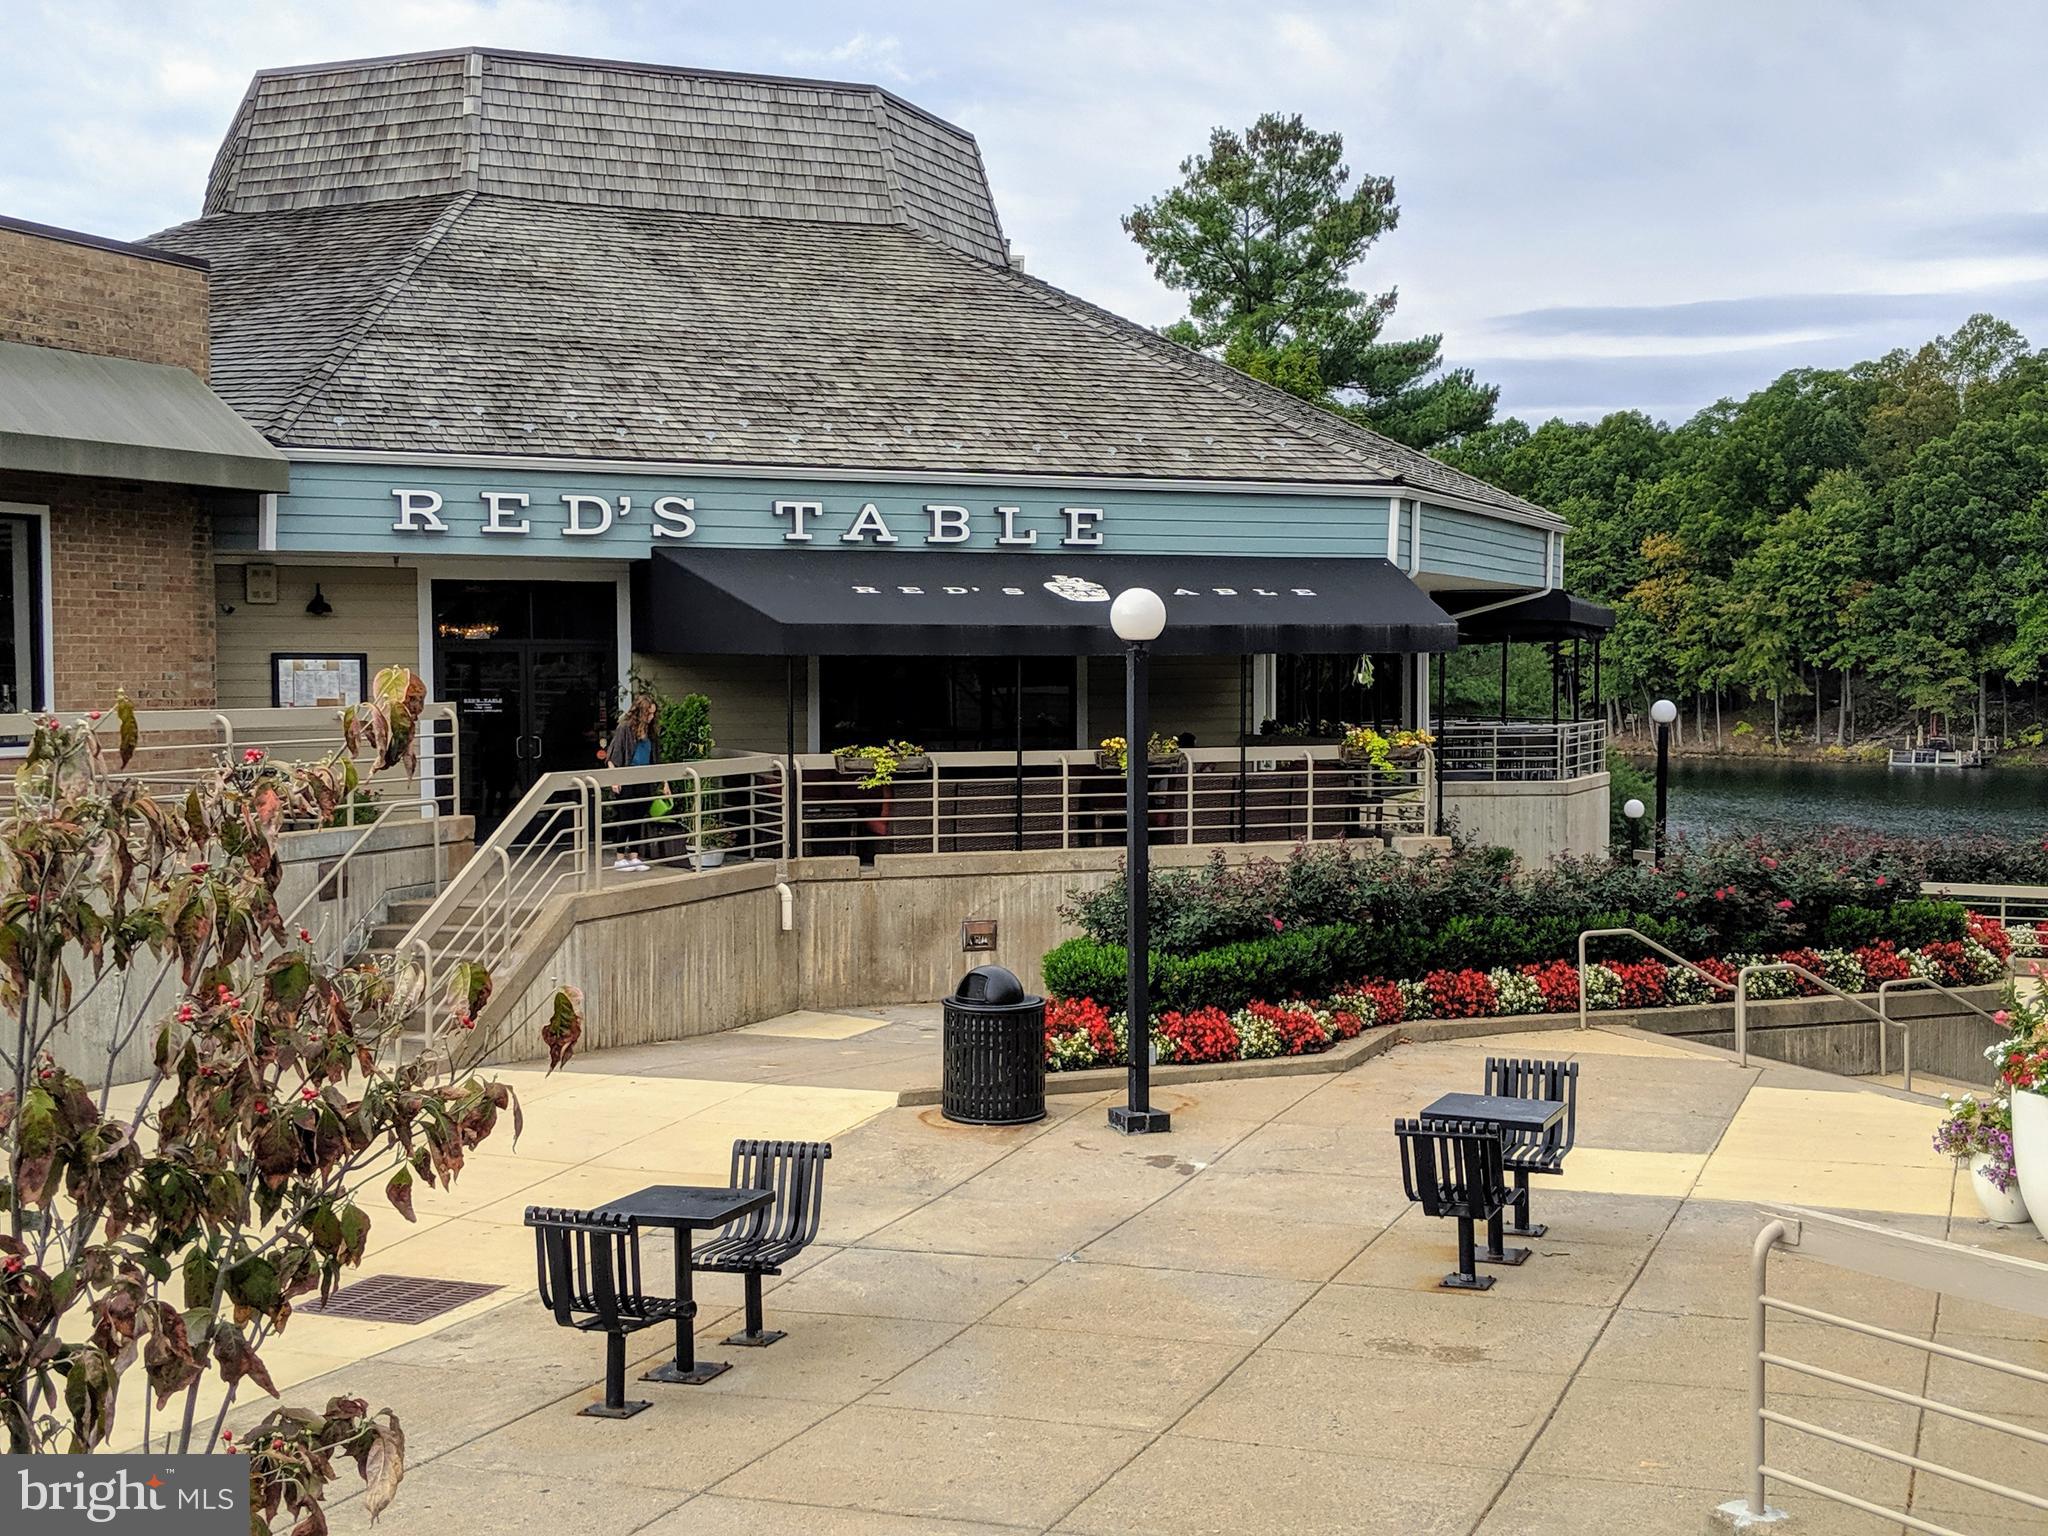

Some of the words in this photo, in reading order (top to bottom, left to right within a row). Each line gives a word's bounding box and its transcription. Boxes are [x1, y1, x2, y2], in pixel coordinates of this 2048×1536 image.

[391, 488, 697, 538] RED'S
[772, 500, 1104, 545] TABLE
[851, 586, 1025, 595] RED'S
[1173, 588, 1318, 596] ABLE
